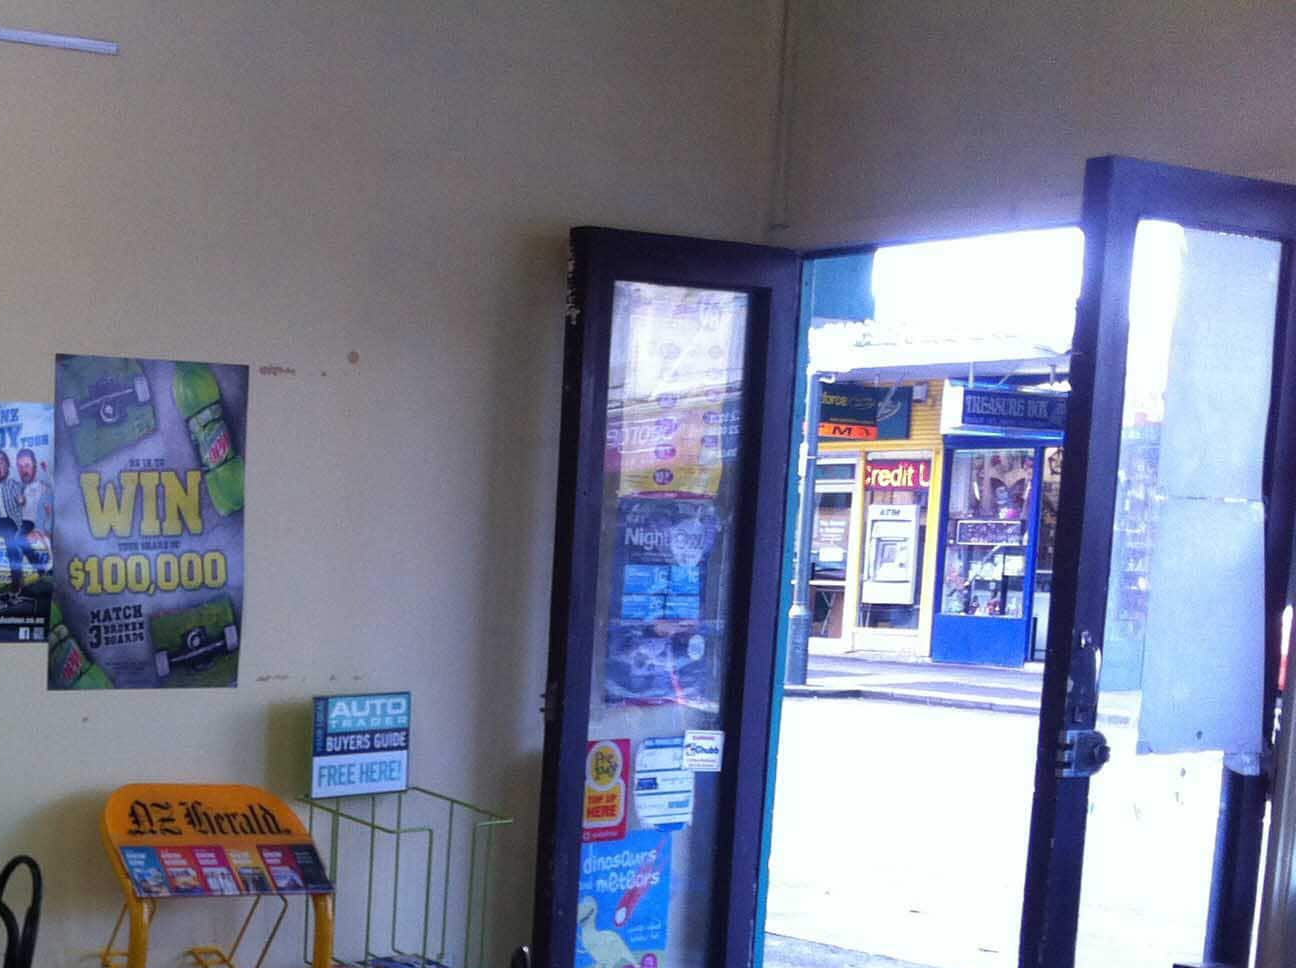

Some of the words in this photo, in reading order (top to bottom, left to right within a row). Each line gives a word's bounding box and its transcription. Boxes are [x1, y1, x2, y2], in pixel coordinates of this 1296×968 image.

[78, 469, 204, 541] WIN
[68, 550, 228, 597] $100,000
[89, 604, 143, 624] MATCH
[88, 624, 102, 649] 3
[329, 698, 407, 718] AUTO
[326, 734, 371, 752] BUYERS
[373, 731, 407, 749] GUIDE
[318, 764, 357, 787] FREE
[583, 849, 657, 875] dinosaurs
[596, 870, 661, 893] meteors
